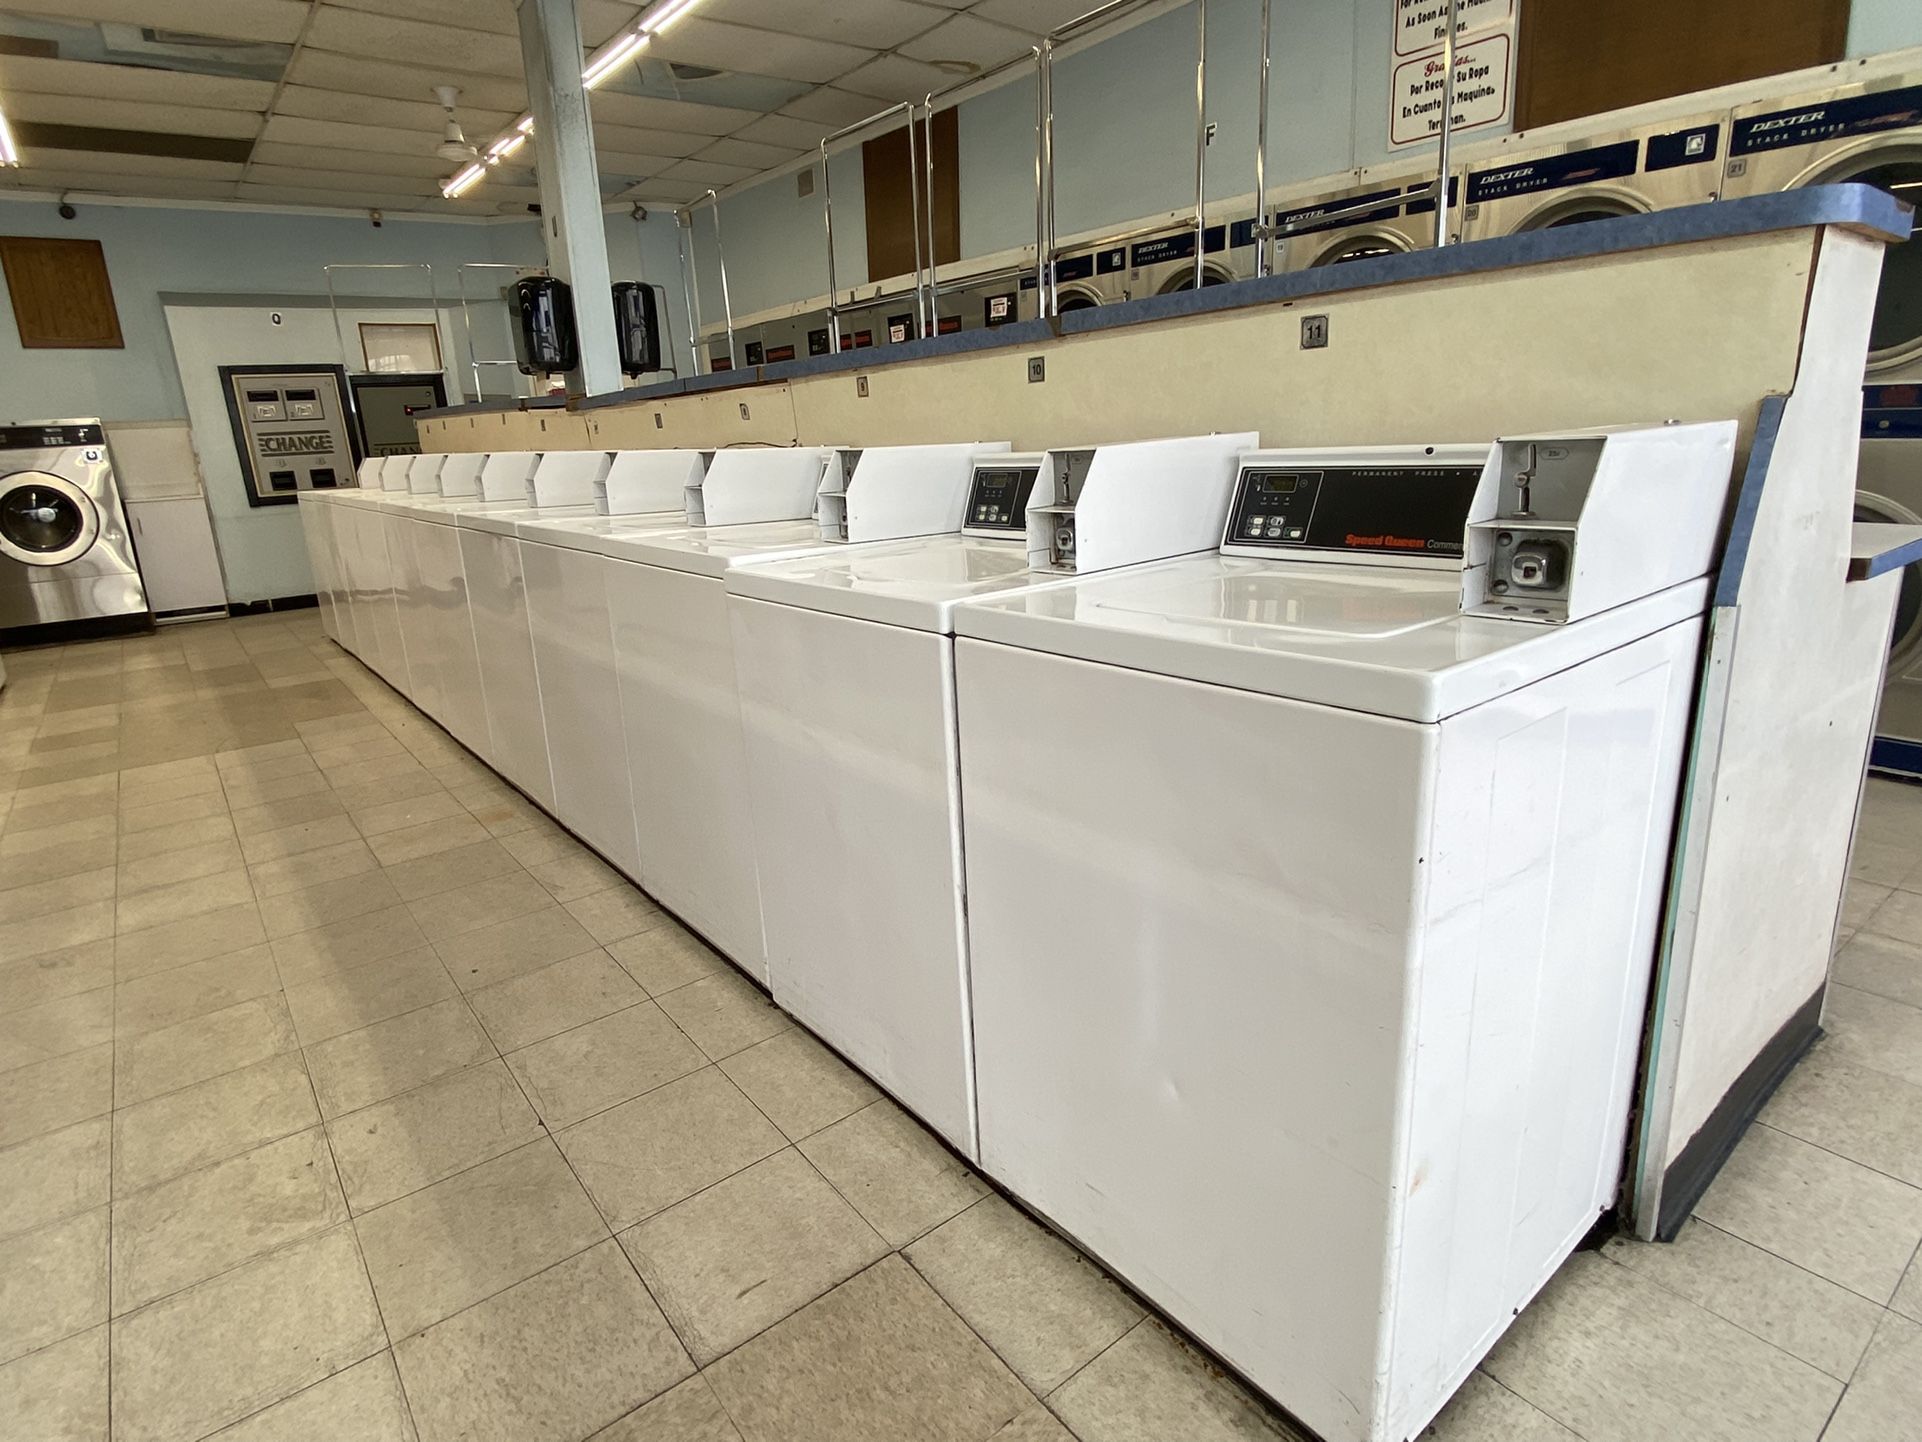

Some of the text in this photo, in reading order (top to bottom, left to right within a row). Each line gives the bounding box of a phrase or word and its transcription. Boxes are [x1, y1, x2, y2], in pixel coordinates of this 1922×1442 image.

[1406, 16, 1415, 28] As
[1417, 10, 1437, 24] Soon
[1438, 5, 1449, 17] As
[1410, 84, 1423, 96] Por
[1456, 70, 1467, 83] Su
[1468, 65, 1489, 79] Ropa
[1402, 106, 1412, 118] En
[1413, 98, 1442, 115] Cuanto
[1750, 111, 1826, 133] DEXTER
[1801, 122, 1846, 137] DRYER
[1480, 167, 1535, 185] DEXTER
[1730, 163, 1742, 173] 21
[1285, 209, 1326, 224] DEXTER
[1307, 324, 1321, 340] 11
[1032, 363, 1042, 376] 10
[265, 435, 327, 452] CHANGE
[1345, 534, 1383, 546] Speed
[1384, 535, 1425, 548] Queen
